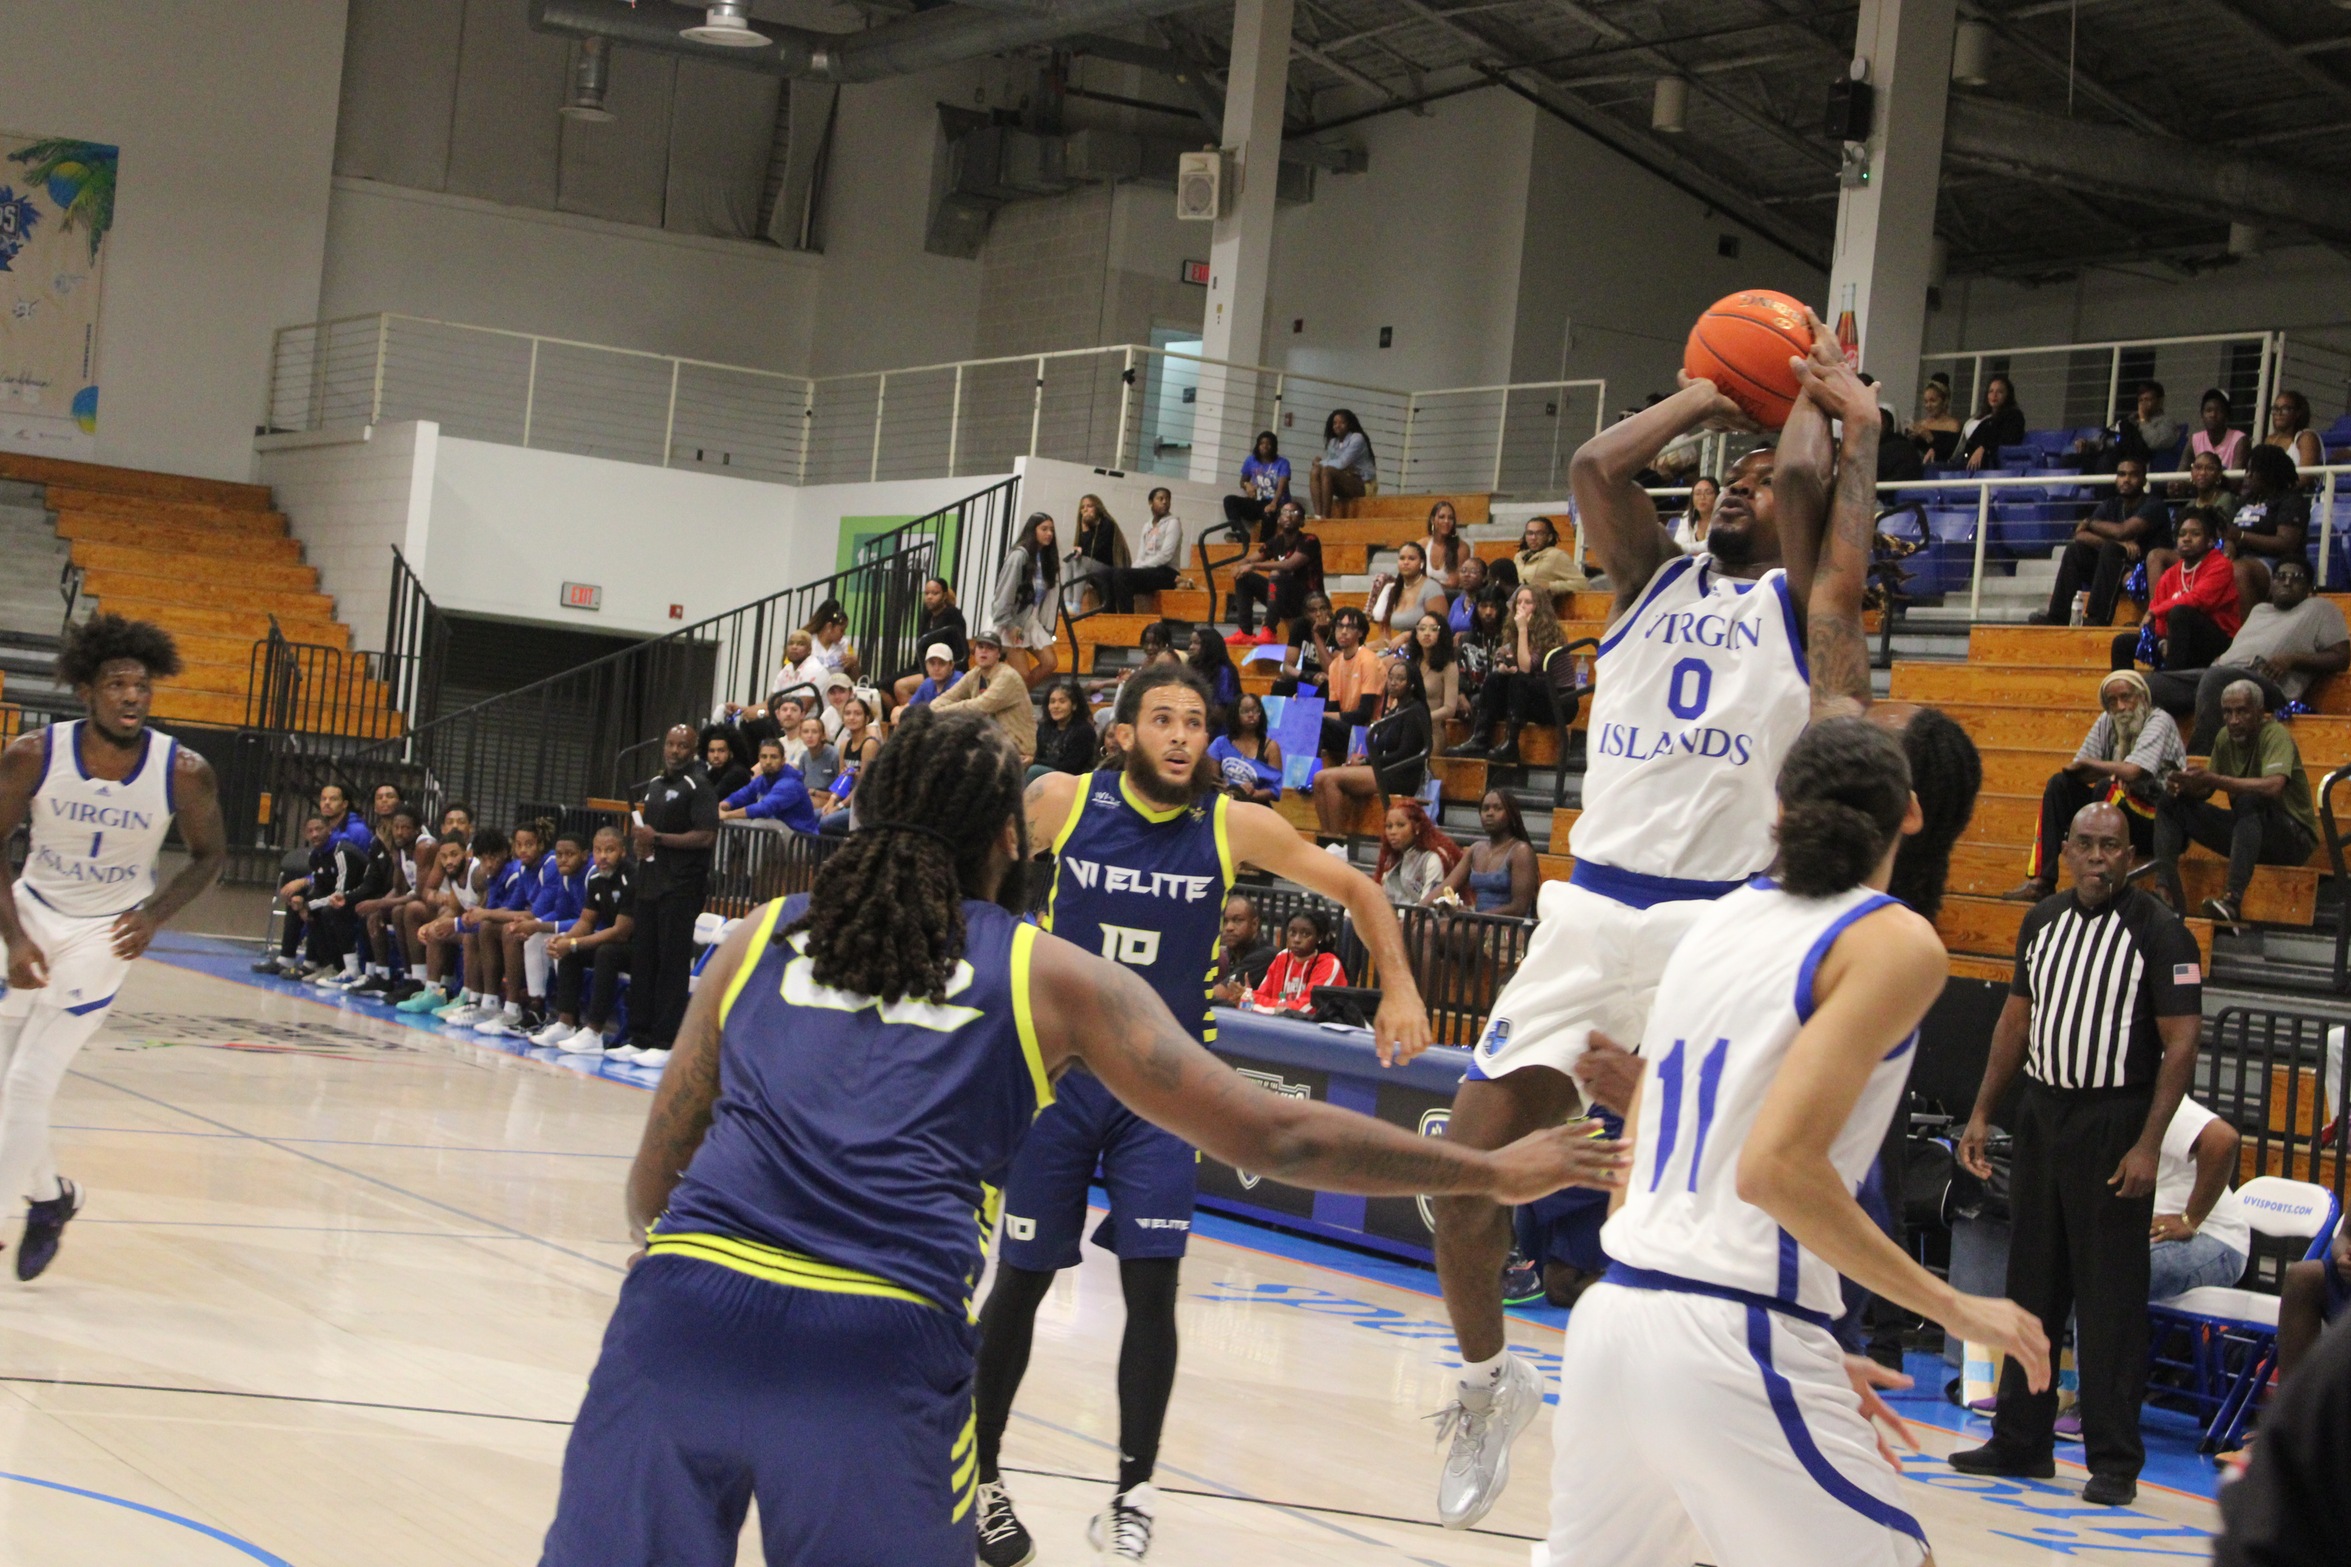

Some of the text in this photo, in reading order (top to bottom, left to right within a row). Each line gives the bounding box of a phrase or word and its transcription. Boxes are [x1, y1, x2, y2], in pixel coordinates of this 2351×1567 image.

[571, 585, 594, 605] EXIT
[1667, 657, 1713, 721] 0
[1598, 722, 1753, 766] ISLANDS
[50, 798, 153, 830] VIRGIN
[89, 831, 104, 858] 1
[1065, 856, 1215, 904] VI ELITE
[1098, 922, 1162, 967] 10
[1649, 1037, 1731, 1194] 11
[2243, 1195, 2314, 1216] UVISPORTS.COM
[1005, 1213, 1037, 1242] 10
[1151, 1218, 1192, 1231] ELITE
